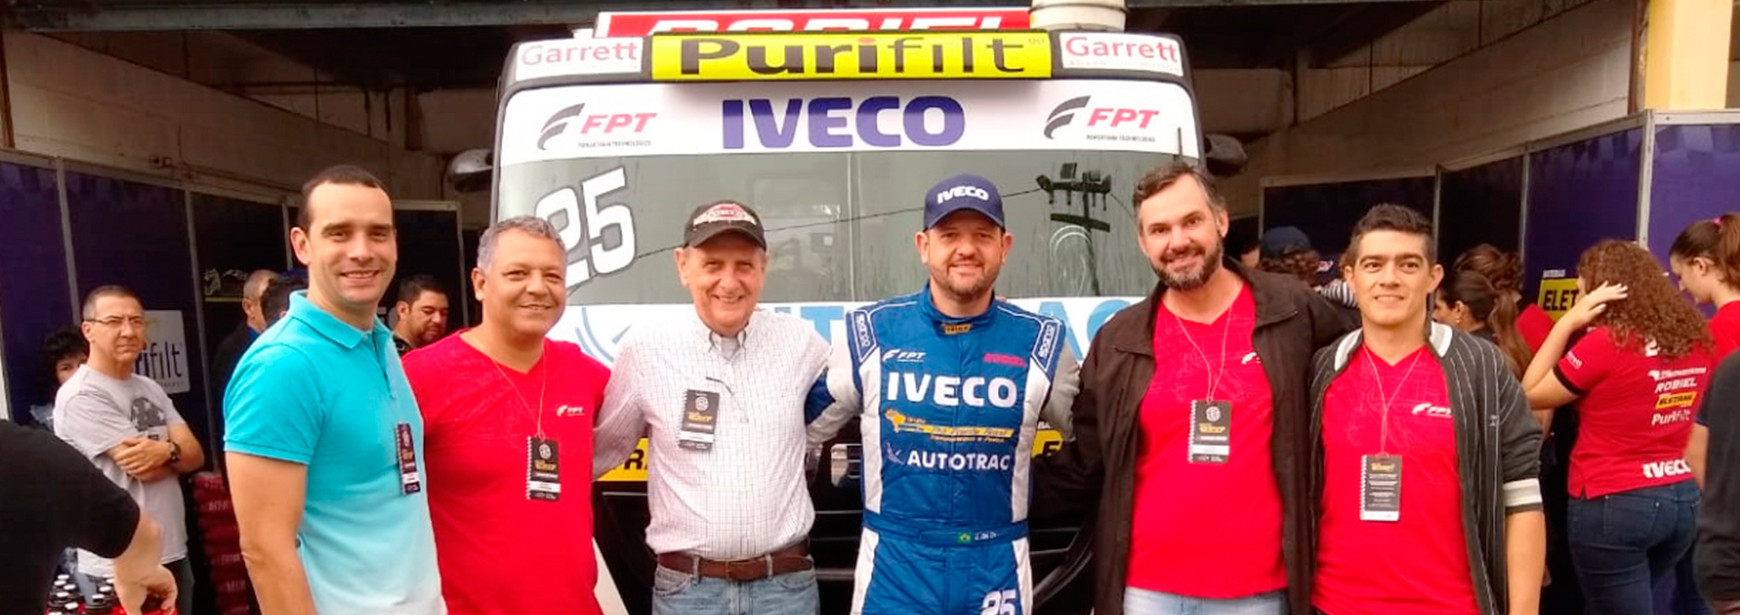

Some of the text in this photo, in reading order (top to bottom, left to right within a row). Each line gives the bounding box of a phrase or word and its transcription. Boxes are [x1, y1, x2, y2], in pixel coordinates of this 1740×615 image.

[521, 42, 637, 66] Garrett
[681, 36, 1025, 75] Purifilt
[1065, 36, 1178, 63] Garrett
[580, 113, 658, 134] FPT
[722, 96, 966, 149] IVECO
[1087, 108, 1160, 129] FPT
[937, 185, 989, 204] IVECO
[535, 167, 636, 289] 25
[1543, 289, 1579, 311] ELET
[134, 341, 182, 380] rifilt
[887, 371, 1017, 408] IVECO
[907, 450, 1010, 470] AUTOTRAC
[980, 589, 1016, 615] 25
